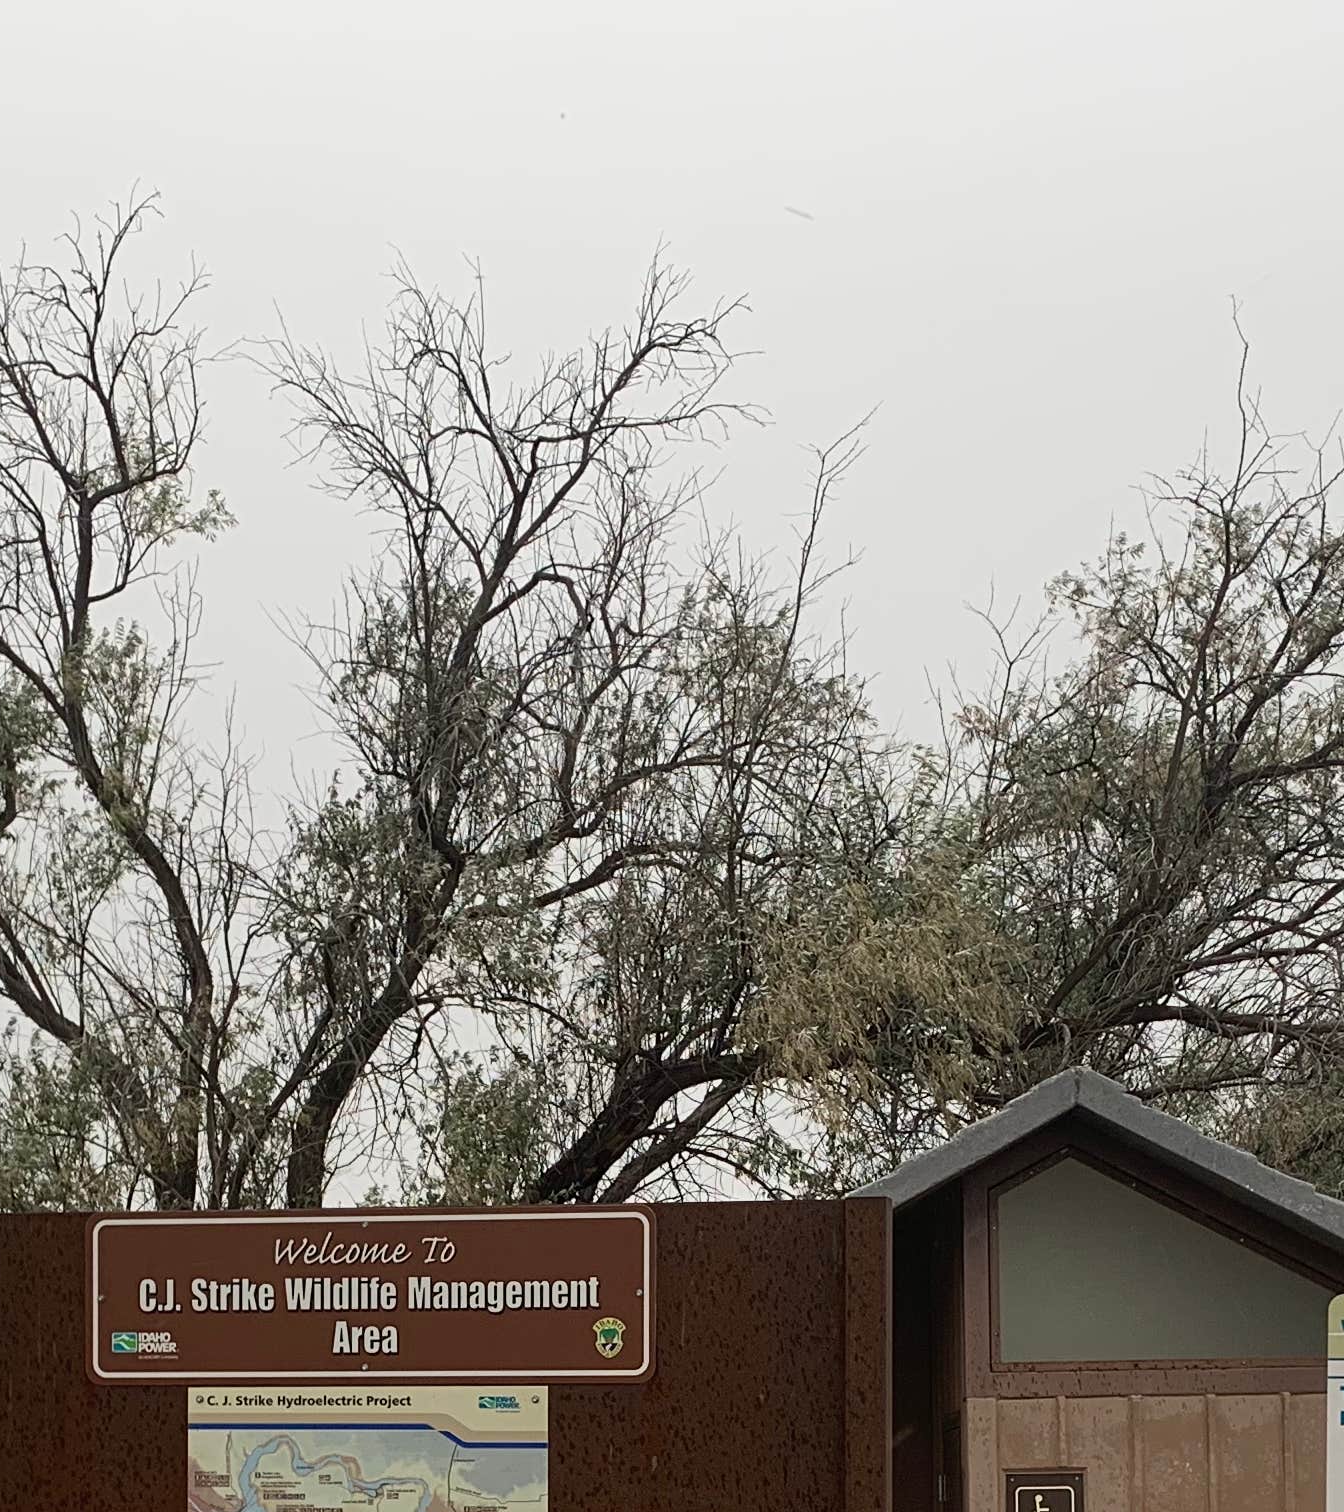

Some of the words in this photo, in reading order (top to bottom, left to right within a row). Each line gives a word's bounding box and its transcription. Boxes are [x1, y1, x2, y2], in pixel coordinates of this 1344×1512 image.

[274, 1232, 412, 1264] Welcome
[421, 1236, 455, 1263] To
[139, 1278, 181, 1312] C.J.
[191, 1277, 274, 1311] Strike
[284, 1276, 396, 1310] Wildlife
[407, 1275, 599, 1313] Management
[595, 1319, 624, 1330] IDAHO
[135, 1331, 171, 1343] IDAHO
[332, 1320, 398, 1353] Area
[135, 1342, 177, 1353] POWER
[206, 1394, 219, 1406] C.
[221, 1395, 232, 1406] J.
[235, 1394, 273, 1406] Strike
[276, 1394, 363, 1409] Hydroelectric
[365, 1394, 412, 1409] Project
